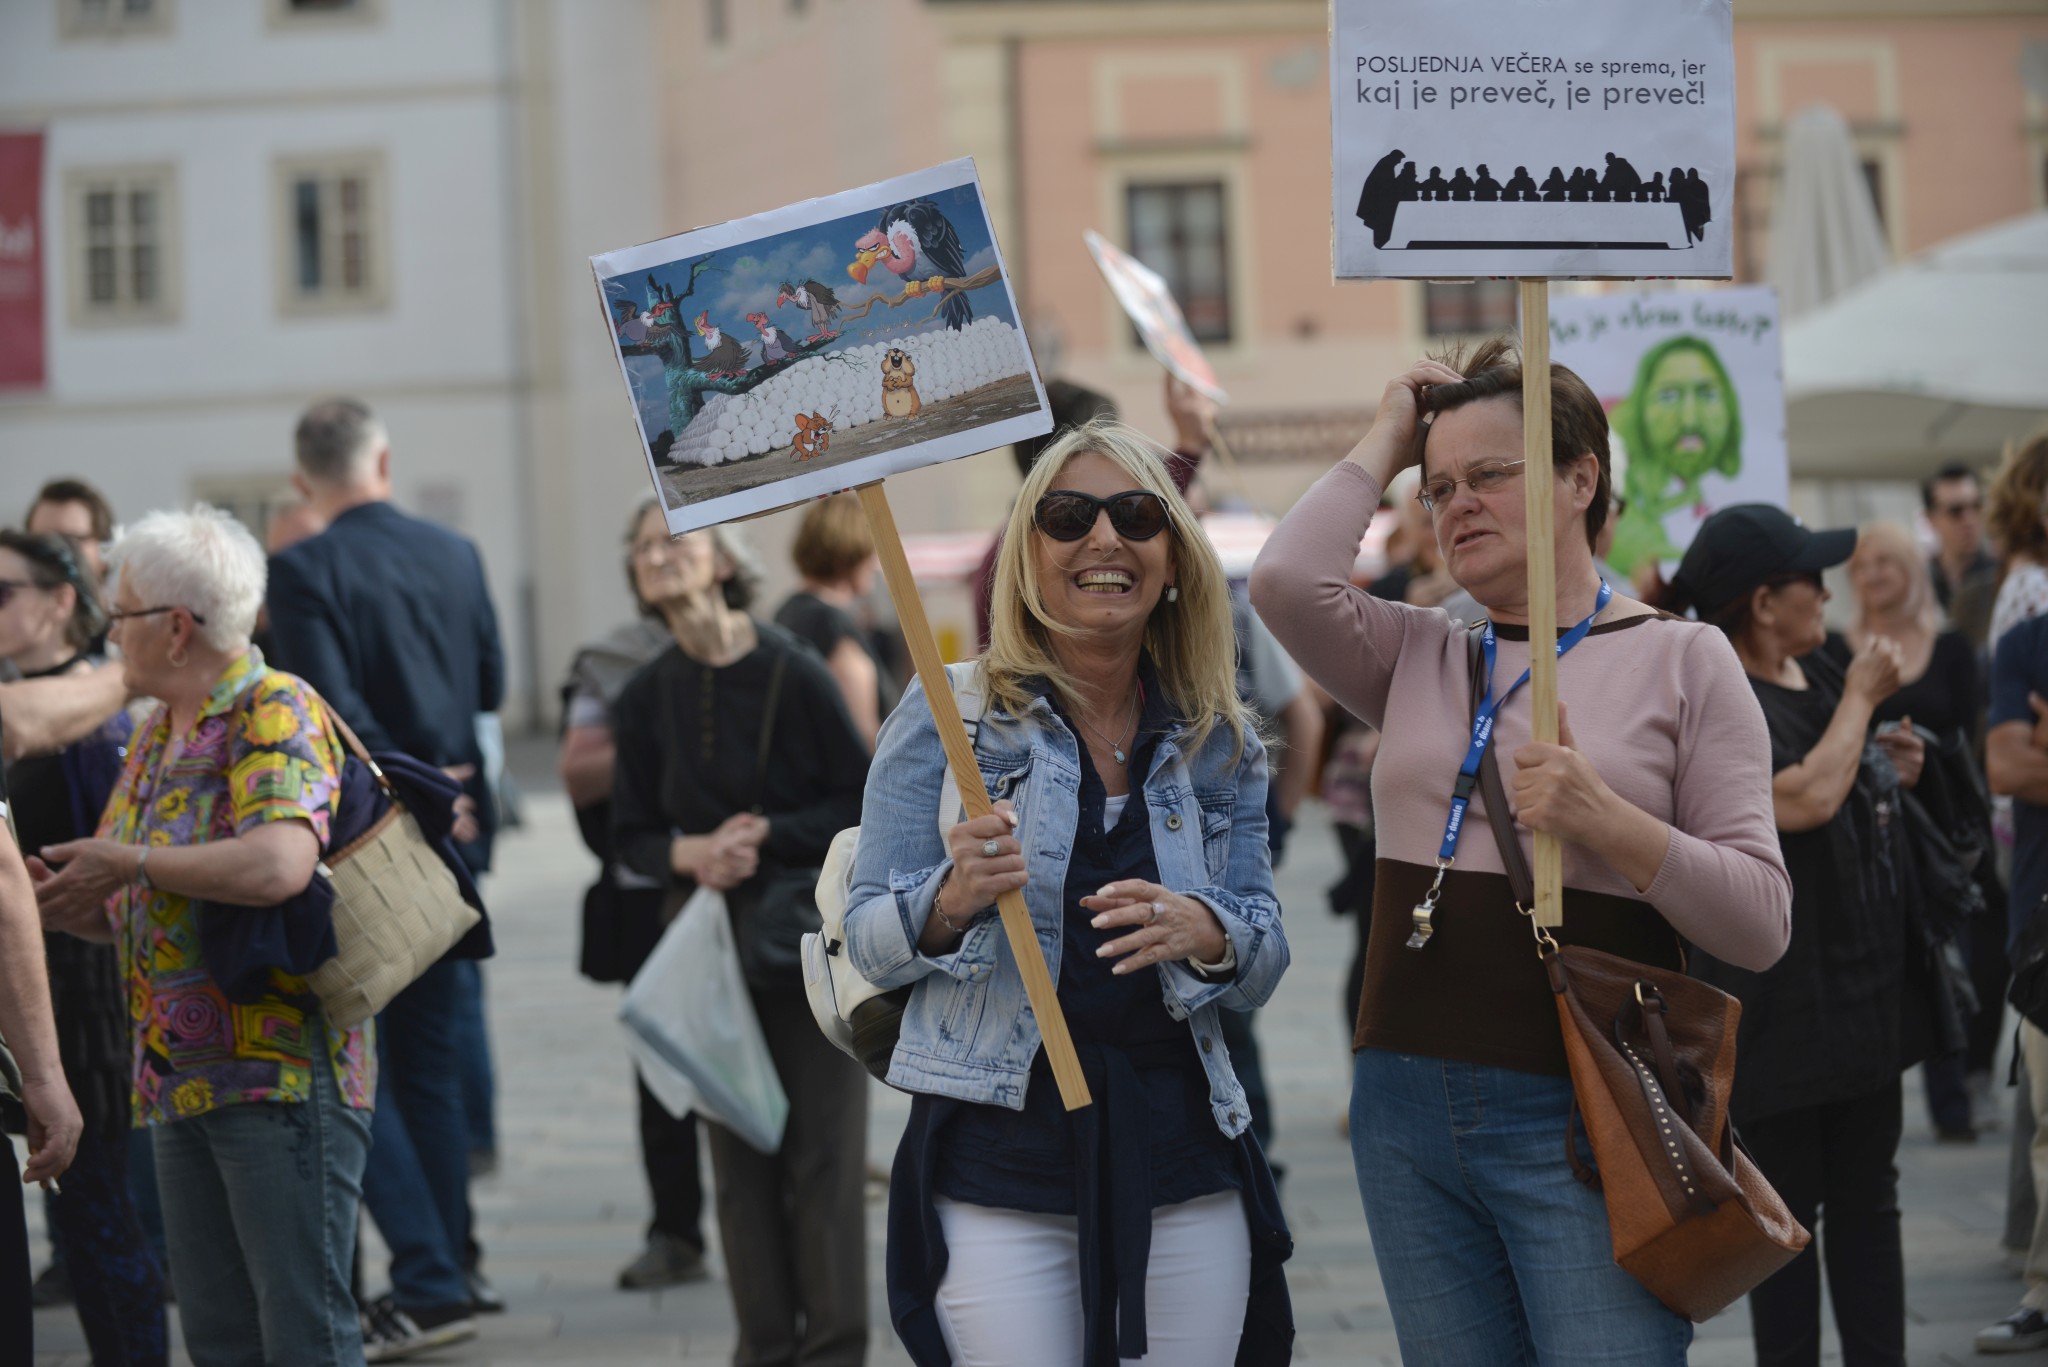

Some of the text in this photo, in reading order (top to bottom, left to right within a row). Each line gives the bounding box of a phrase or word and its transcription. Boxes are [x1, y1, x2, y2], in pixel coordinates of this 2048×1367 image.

[1356, 52, 1706, 79] POSLJEDNJA VEČERA se sprema, jer
[1357, 78, 1705, 110] kaj je preveč, je preveč!
